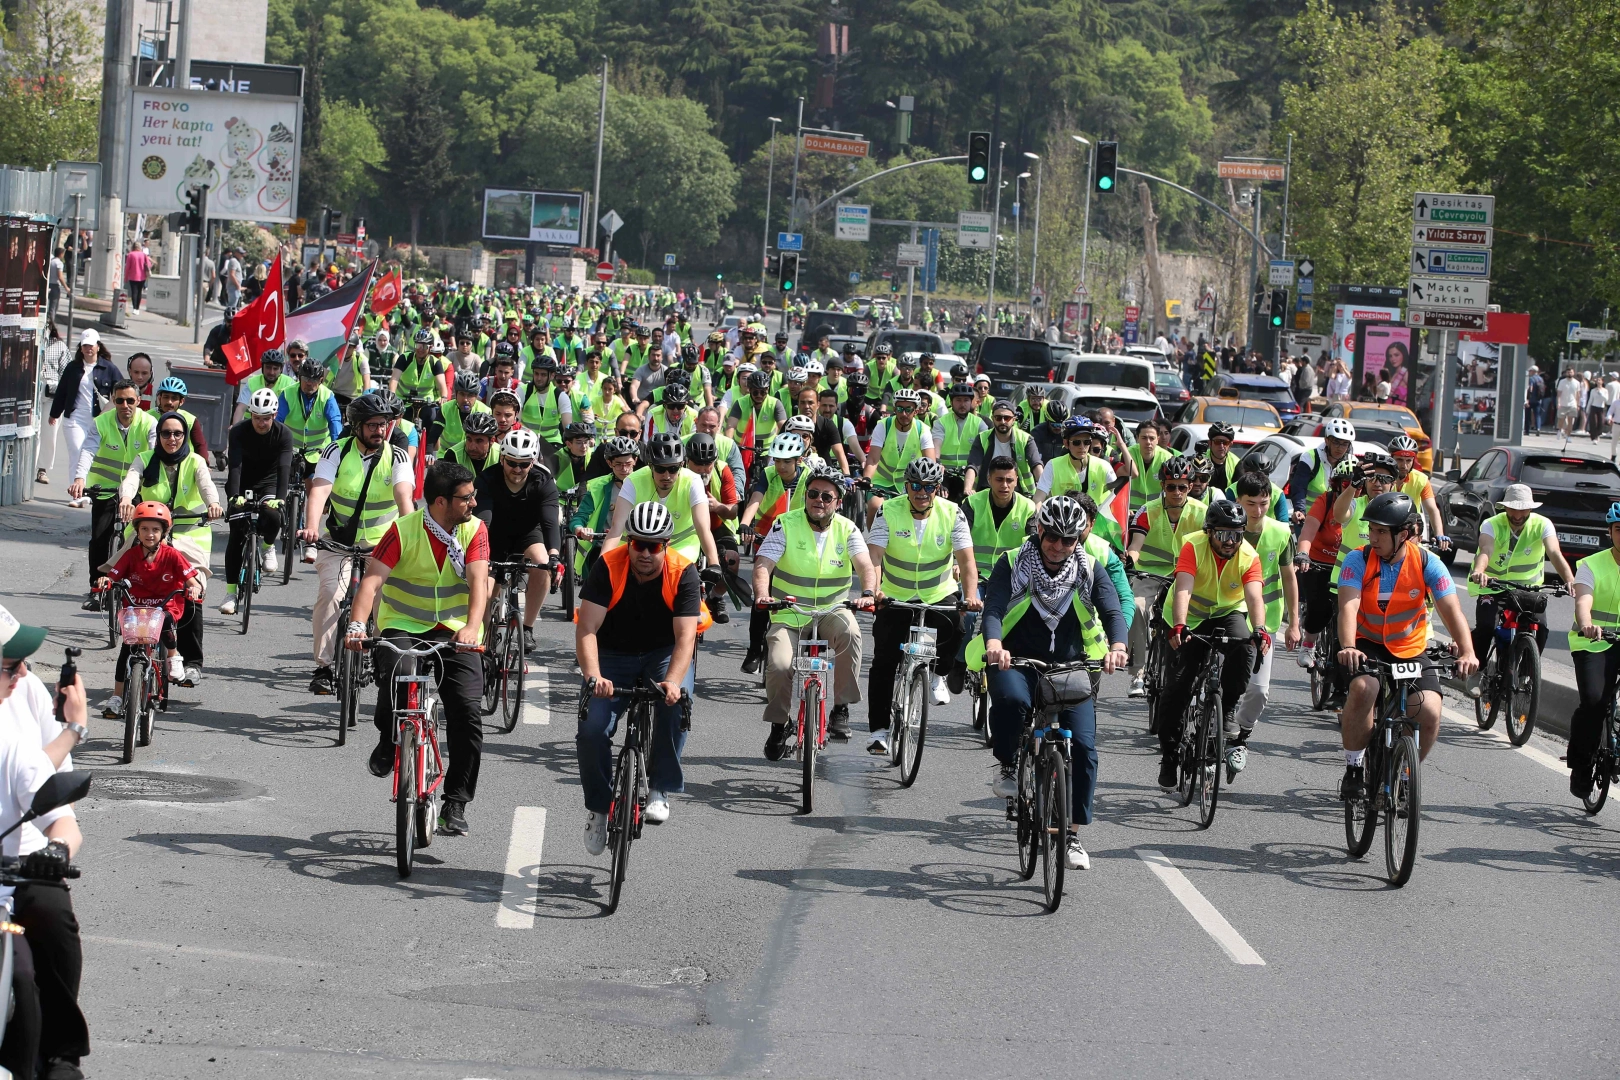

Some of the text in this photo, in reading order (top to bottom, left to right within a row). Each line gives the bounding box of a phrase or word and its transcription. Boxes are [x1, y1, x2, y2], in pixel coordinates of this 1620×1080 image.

[143, 100, 189, 112] FROYO
[142, 115, 214, 133] Her kapta
[140, 134, 202, 148] yeni tat!
[806, 139, 865, 153] DOLMABAHÇE
[1432, 197, 1483, 209] Beşiktaş
[1428, 229, 1486, 243] Yıldız Sarayı
[1447, 263, 1484, 271] Kağıthane
[1427, 282, 1469, 293] Maçka
[1426, 294, 1474, 304] Taksim
[1353, 311, 1390, 320] ANNESİNİN
[1425, 312, 1473, 321] Dolmabahçe
[1436, 319, 1461, 327] Sarayı
[1396, 662, 1417, 674] 60
